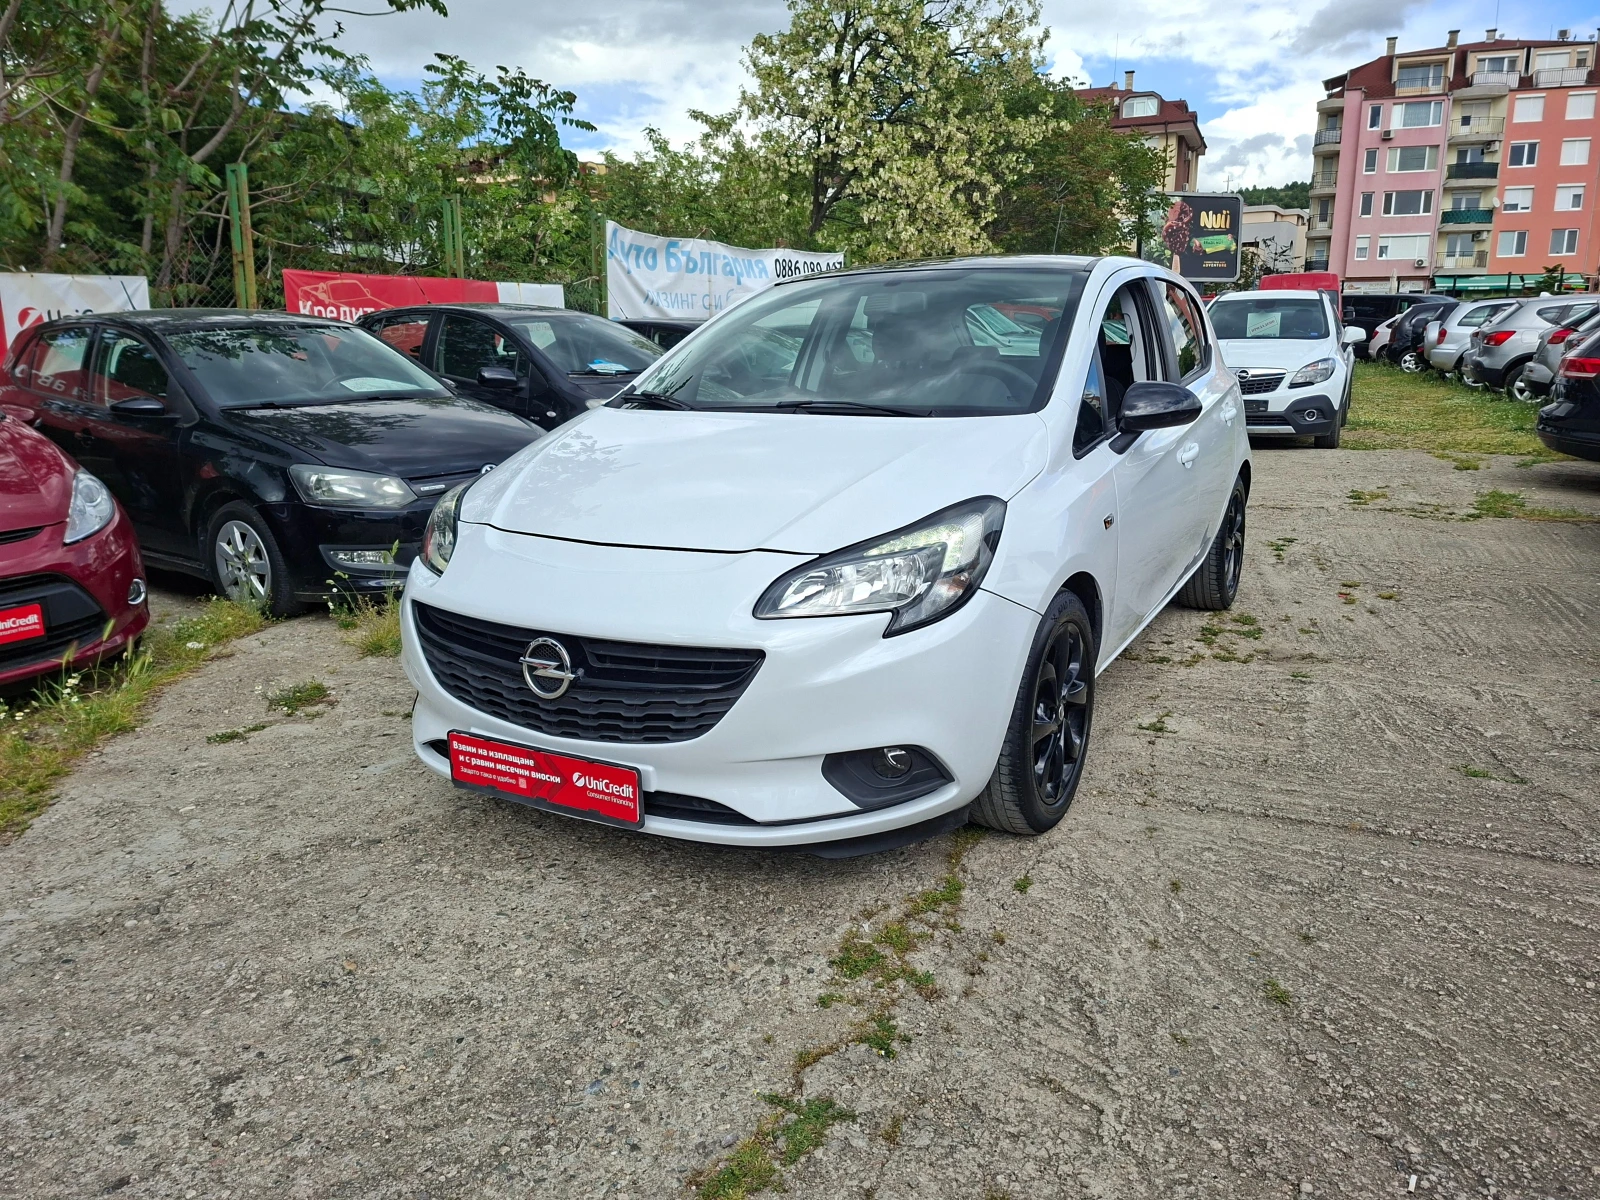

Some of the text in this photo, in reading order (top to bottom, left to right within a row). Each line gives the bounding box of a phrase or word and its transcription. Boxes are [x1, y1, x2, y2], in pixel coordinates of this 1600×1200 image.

[1200, 210, 1230, 229] Nuii
[608, 228, 769, 285] Ауто България
[775, 258, 801, 278] 0886
[452, 740, 535, 766] Вземи на изплащане
[471, 757, 495, 769] равни
[496, 764, 530, 777] месечни
[531, 770, 561, 784] вноски
[480, 771, 493, 779] така
[585, 775, 634, 799] UniCredit
[586, 790, 634, 809] Consumer Financing
